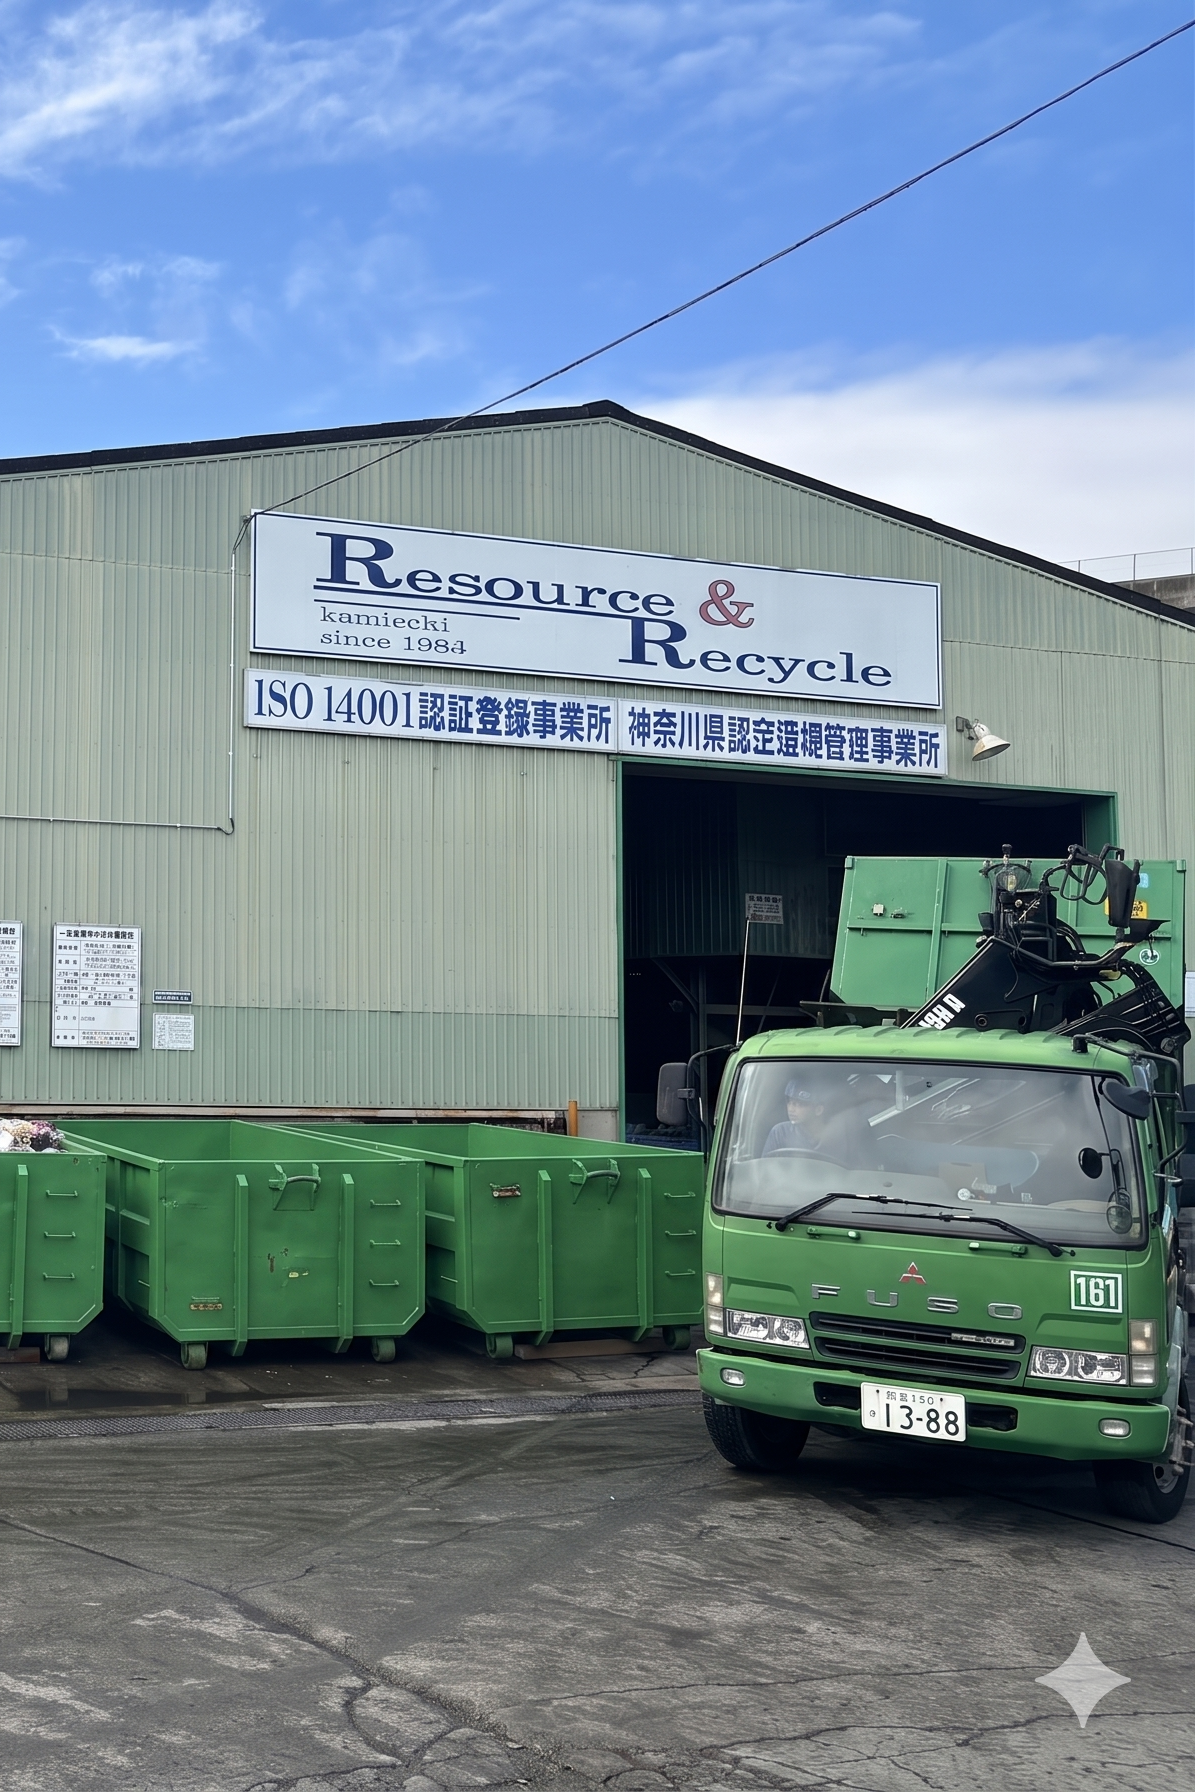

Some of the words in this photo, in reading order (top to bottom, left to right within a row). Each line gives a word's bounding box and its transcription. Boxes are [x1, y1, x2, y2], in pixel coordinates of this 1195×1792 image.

[315, 531, 675, 617] Resource
[698, 579, 755, 629] &
[320, 630, 391, 649] since
[618, 617, 892, 687] Recycle
[254, 679, 313, 719] ISO
[811, 1283, 1023, 1320] FUSO
[1076, 1276, 1116, 1307] 161
[885, 1402, 960, 1437] 13-88
